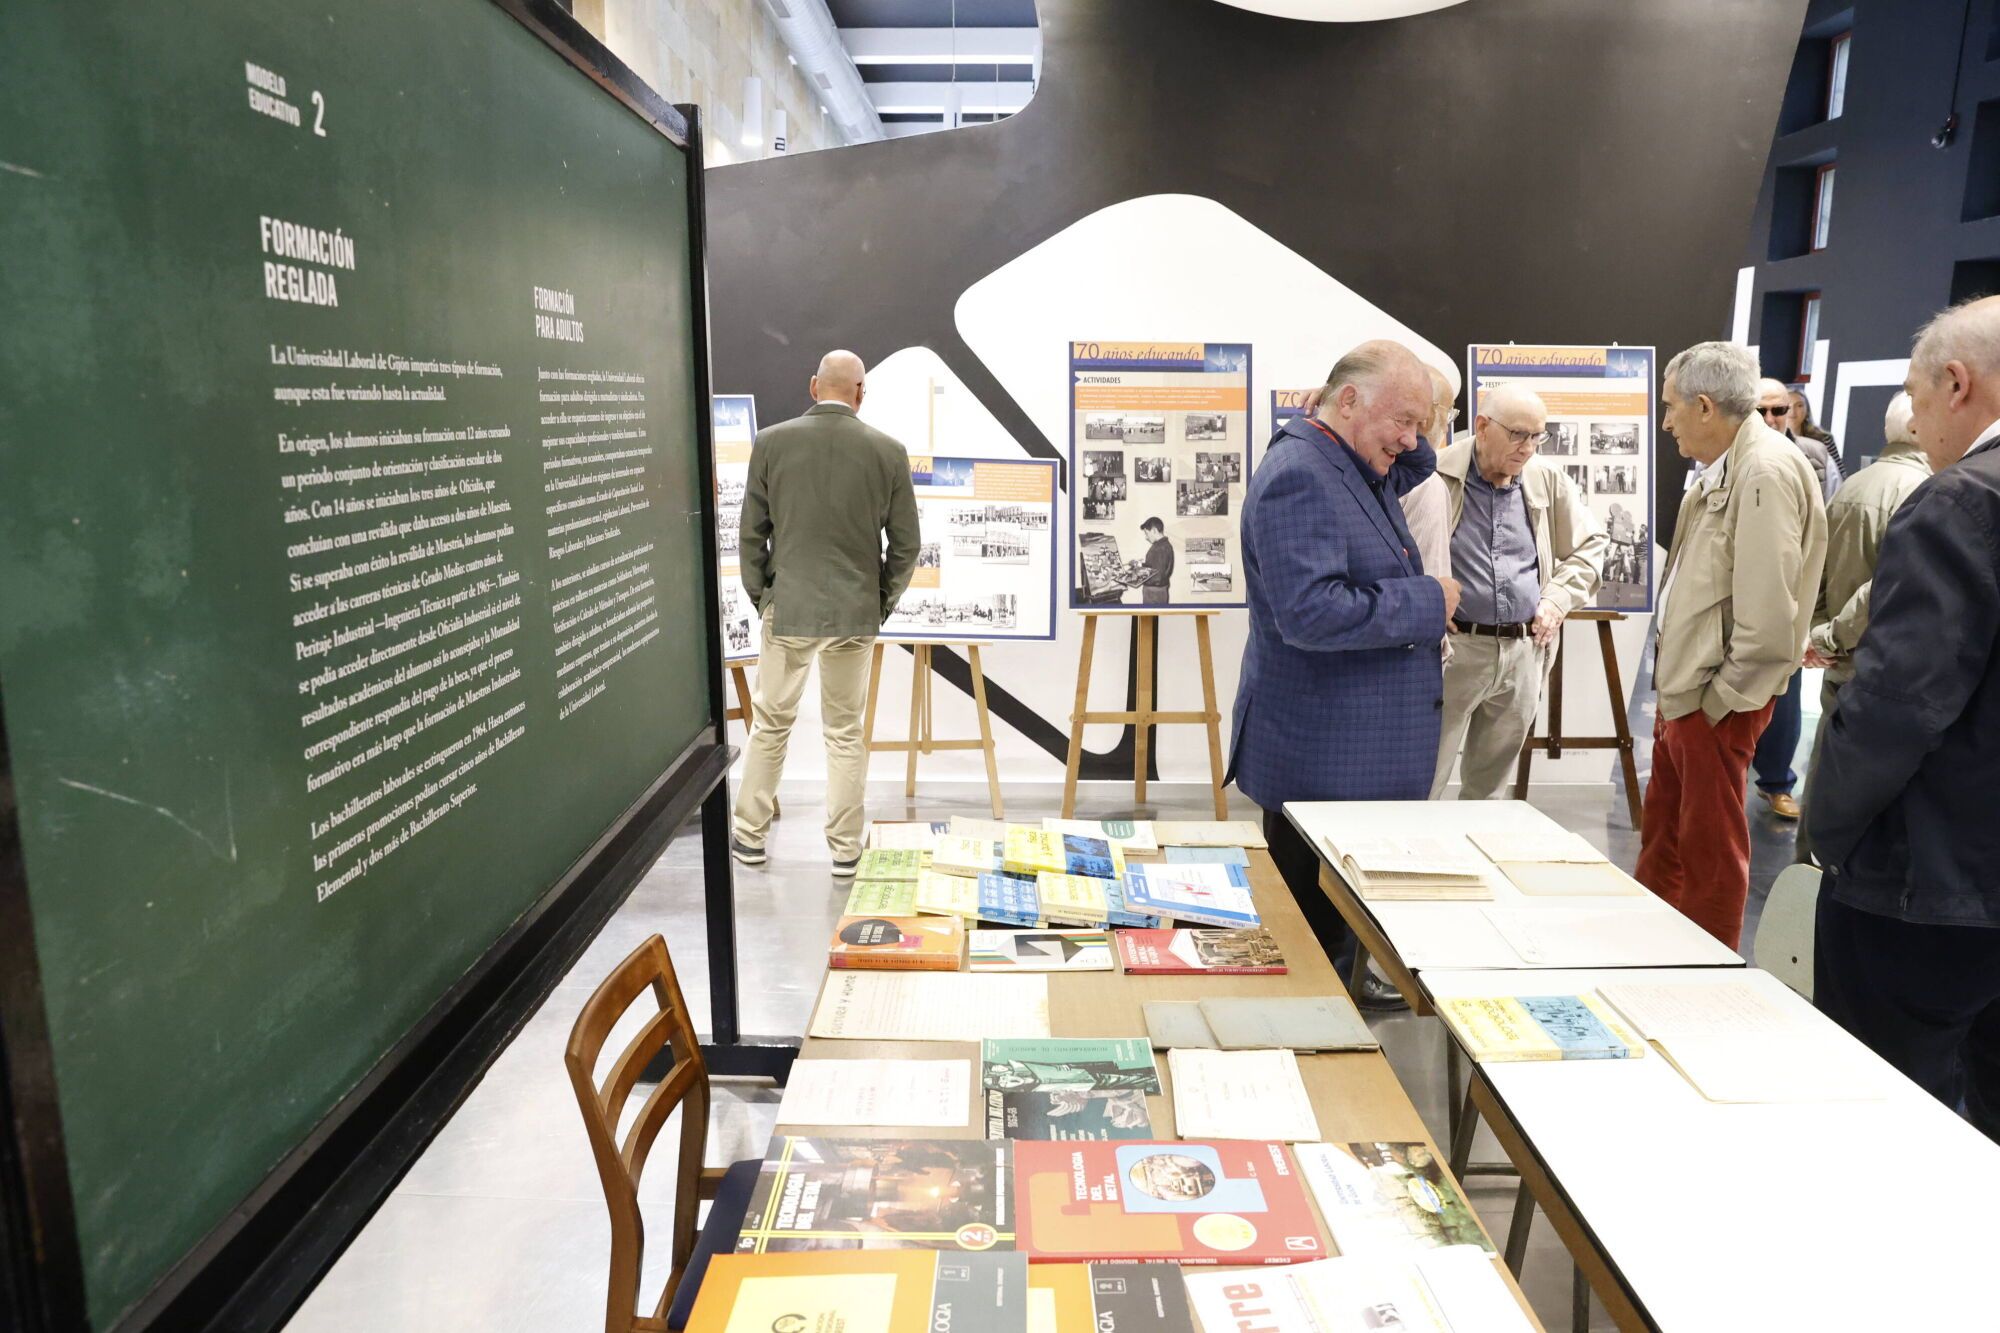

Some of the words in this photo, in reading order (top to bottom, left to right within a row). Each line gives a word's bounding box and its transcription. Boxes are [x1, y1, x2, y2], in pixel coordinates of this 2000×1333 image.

[245, 61, 286, 97] MODELO
[248, 87, 300, 127] EDUCATIVO
[311, 90, 326, 137] 2
[260, 215, 355, 270] FORMACIÓN
[264, 261, 338, 307] REGLADA
[534, 286, 574, 316] FORMACIÓN
[536, 314, 555, 340] PARA
[556, 317, 584, 343] ADULTOS
[271, 345, 287, 364] La
[287, 346, 343, 367] Universidad
[343, 351, 376, 369] Laboral
[377, 354, 387, 369] de
[388, 354, 410, 375] Gijón
[1076, 343, 1099, 360] 70
[1101, 347, 1133, 361] años
[1136, 346, 1199, 361] educando
[1479, 349, 1502, 365] 70
[1505, 354, 1536, 366] años
[1539, 352, 1601, 367] educando
[274, 388, 311, 406] aunque
[312, 388, 331, 400] esta
[331, 383, 345, 400] fue
[346, 384, 382, 400] variando
[382, 385, 403, 400] hasta
[1083, 376, 1121, 384] ACTIVIDADES
[279, 434, 295, 452] En
[296, 435, 330, 456] origen,
[329, 432, 343, 449] los
[344, 431, 378, 448] alumnos
[282, 475, 296, 488] un
[297, 466, 334, 492] periodo
[334, 465, 371, 485] conjunto
[372, 461, 382, 477] de
[285, 506, 311, 523] años.
[311, 501, 332, 518] Con
[334, 499, 346, 514] 14
[346, 498, 366, 512] años
[366, 499, 375, 509] se
[334, 535, 351, 547] con
[351, 532, 368, 544] una
[399, 523, 413, 538] que
[413, 515, 430, 530] daba
[455, 508, 467, 521] dos
[290, 574, 303, 592] Si
[303, 577, 313, 589] se
[314, 562, 354, 589] superaba
[354, 563, 370, 575] con
[370, 555, 390, 571] éxito
[390, 551, 399, 566] la
[294, 602, 329, 626] acceder
[335, 597, 349, 613] las
[350, 591, 382, 608] carreras
[421, 568, 443, 586] Grado
[296, 635, 333, 660] Peritaje
[333, 618, 376, 647] Industrial
[299, 681, 311, 693] se
[338, 654, 370, 678] acceder
[370, 638, 418, 664] directamente
[302, 696, 347, 727] resultados
[349, 678, 394, 706] académicos
[394, 667, 406, 685] del
[406, 661, 433, 679] alumno
[305, 718, 374, 759] correspondiente
[411, 689, 423, 706] del
[423, 686, 440, 705] pago
[307, 761, 352, 792] formativo
[352, 753, 366, 767] era
[383, 733, 403, 751] largo
[403, 726, 417, 743] que
[311, 821, 330, 839] Los
[330, 789, 383, 827] bachilleratos
[314, 855, 328, 871] las
[328, 830, 366, 867] primeras
[367, 799, 415, 842] promociones
[317, 859, 363, 902] Elemental
[369, 849, 383, 865] dos
[400, 828, 410, 843] de
[1073, 1151, 1085, 1201] TECNOLOGIA
[1268, 1144, 1289, 1176] EVEREST
[777, 1173, 806, 1230] TECNOLOGIA
[803, 1180, 822, 1209] METAL
[1091, 1184, 1102, 1201] DEL
[1104, 1173, 1118, 1201] METAL
[798, 1211, 814, 1229] DEL
[960, 1231, 981, 1242] 2
[740, 1237, 757, 1249] fp
[934, 1302, 952, 1333] OGIA
